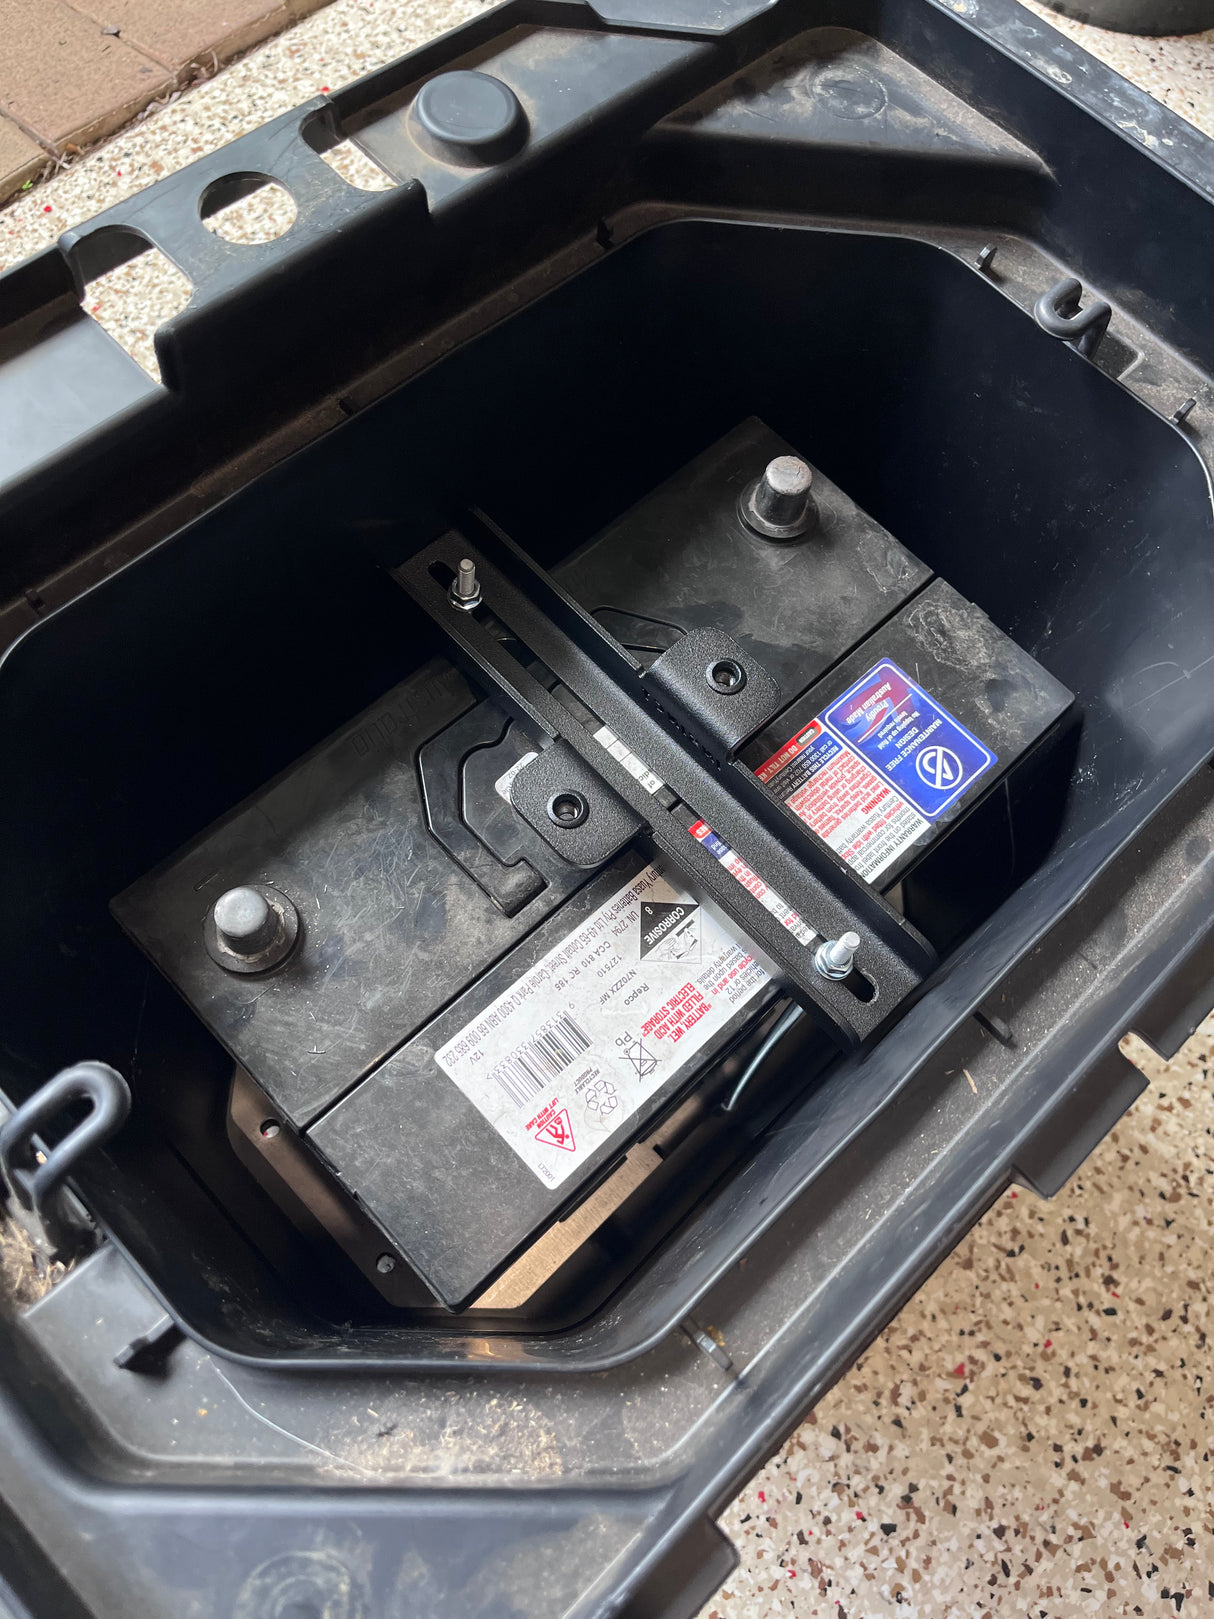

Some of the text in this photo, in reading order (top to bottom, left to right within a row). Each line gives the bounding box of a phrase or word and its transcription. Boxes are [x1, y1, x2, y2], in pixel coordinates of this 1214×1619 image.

[844, 681, 893, 725] Australian Made
[863, 698, 889, 722] Proudly
[876, 720, 896, 738] required
[894, 726, 919, 749] DESIGN
[787, 744, 798, 754] DO
[818, 743, 828, 752] call
[884, 717, 942, 771] MAINTENANCE FREE
[776, 751, 790, 763] NOT
[809, 750, 821, 761] 1300
[817, 744, 839, 764] RECYCLE
[826, 750, 850, 772] Maximum
[763, 760, 780, 775] TILT,
[808, 761, 821, 772] THIS
[844, 764, 866, 784] charging
[790, 769, 811, 788] BATTERY
[805, 768, 828, 789] recharge
[819, 774, 834, 788] metal
[826, 772, 846, 790] provide
[869, 780, 883, 793] Lead
[826, 786, 842, 801] using
[835, 788, 850, 803] away
[848, 788, 863, 801] Keep
[859, 791, 872, 802] acid
[860, 786, 891, 815] WARNING
[810, 798, 829, 816] battery
[825, 801, 838, 814] from
[840, 799, 862, 820] batteries
[877, 793, 899, 814] Century
[883, 800, 905, 821] vehicles
[864, 811, 882, 827] Yuasa
[871, 817, 887, 832] fitted
[890, 806, 910, 824] months
[899, 811, 917, 828] stated
[819, 817, 842, 838] generate
[844, 822, 868, 845] warranty
[860, 829, 874, 842] with
[883, 822, 893, 832] for
[892, 825, 901, 833] on
[892, 817, 923, 847] WARRANTY
[851, 839, 864, 851] Idle
[856, 828, 886, 857] commercial
[873, 839, 887, 853] front
[884, 832, 895, 842] the
[861, 850, 875, 864] label
[631, 876, 653, 897] Yuasa
[610, 890, 638, 916] Batteries
[643, 905, 654, 915] 8
[592, 917, 608, 932] Ltd
[599, 907, 617, 924] Pty
[642, 905, 685, 945] CORROSIVE
[577, 924, 599, 945] 49-65
[610, 919, 629, 937] 2794
[561, 938, 584, 960] Cobalt
[592, 939, 611, 957] CCA
[711, 944, 738, 969] warranty
[579, 953, 596, 968] 810
[595, 953, 622, 978] 127510
[725, 951, 744, 970] based
[526, 967, 552, 990] Carole
[553, 975, 569, 991] 185
[710, 965, 727, 982] upon
[710, 953, 754, 996] cycle use and in
[724, 960, 760, 994] ehicles or 12
[514, 982, 535, 1002] Park
[596, 968, 637, 1005] N70ZZX MF
[622, 981, 650, 1008] Repco
[702, 979, 715, 991] the
[726, 968, 765, 1004] for the period
[509, 993, 522, 1006] Q
[665, 981, 696, 1010] ELECTRIC
[495, 998, 517, 1019] 4300
[652, 990, 704, 1040] FILLED WITH ACID
[475, 1021, 490, 1037] 66
[483, 1010, 503, 1030] ABN
[464, 1028, 482, 1046] 009
[493, 999, 576, 1075] 9 313857 330833
[613, 1030, 633, 1049] Pb
[666, 1024, 685, 1044] WET.
[452, 1038, 471, 1057] 685
[466, 1047, 485, 1065] 12V
[441, 1048, 460, 1067] 232
[571, 1066, 593, 1087] PRODUCT
[572, 1068, 600, 1094] RECYCLABLE
[523, 1096, 559, 1131] LIFT WITH CARE
[535, 1108, 556, 1129] CAUTION
